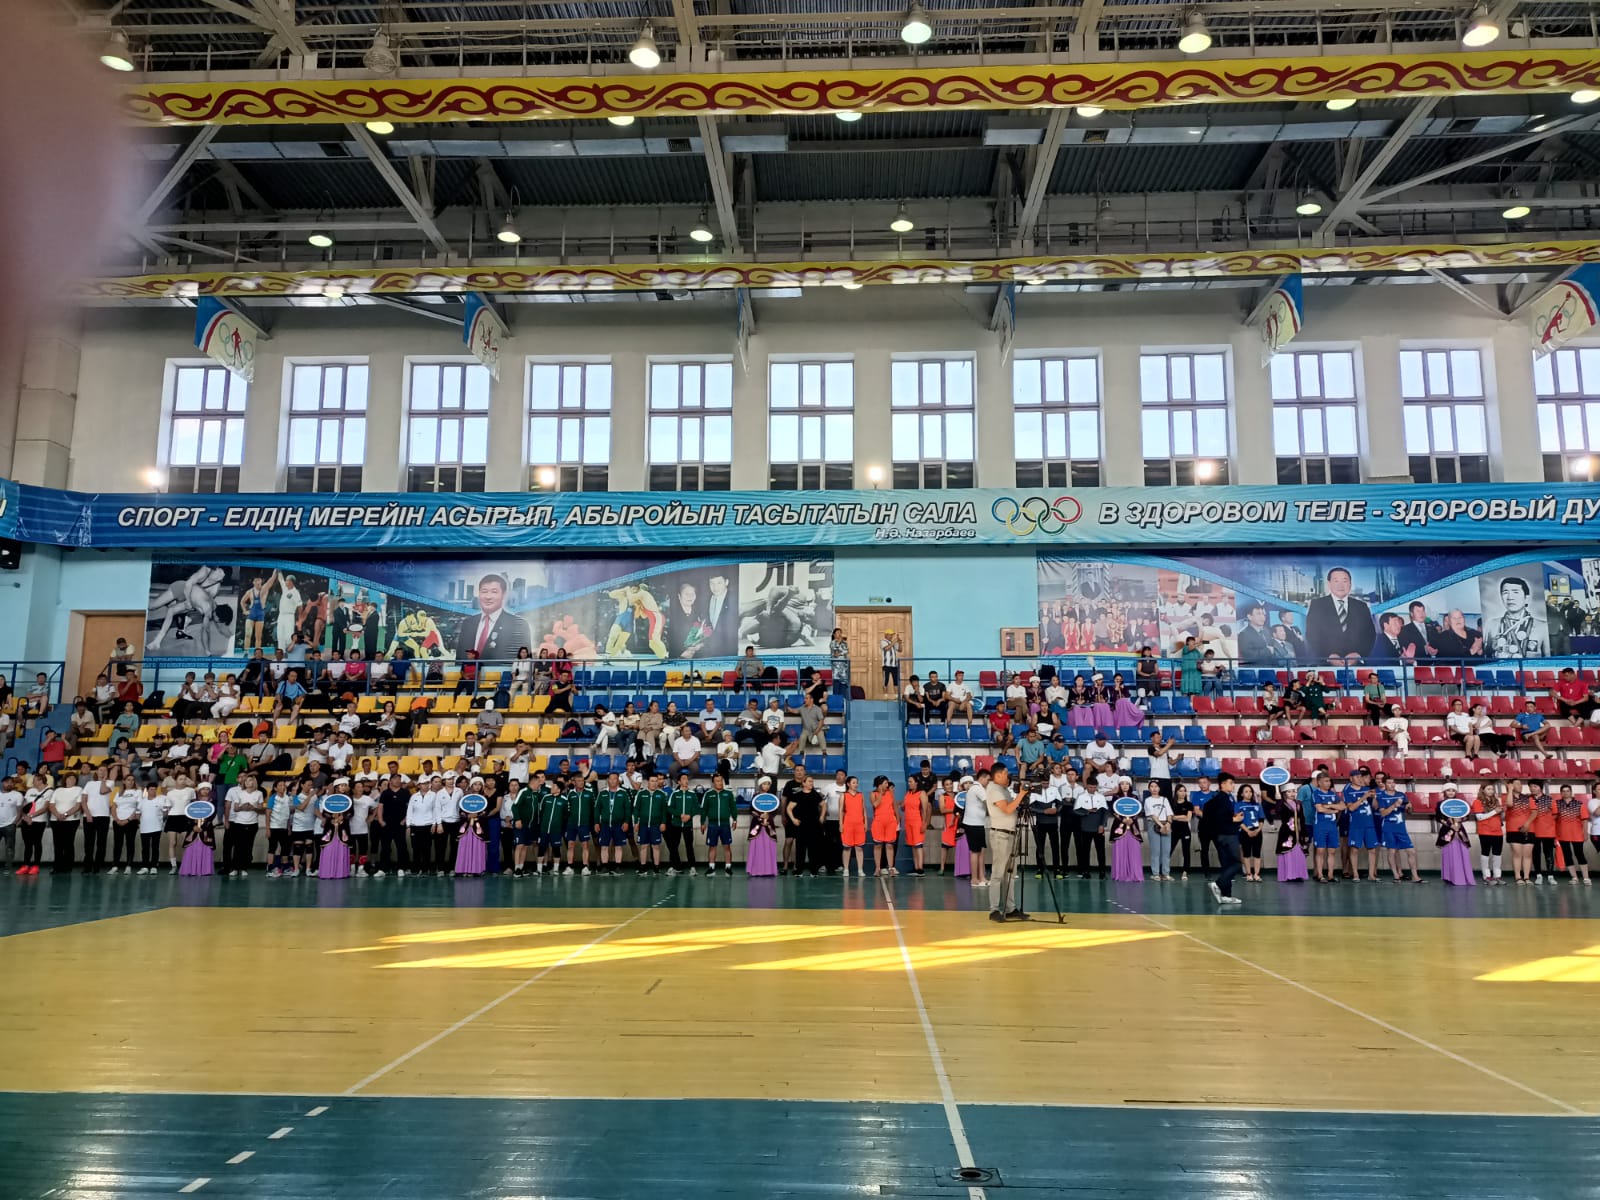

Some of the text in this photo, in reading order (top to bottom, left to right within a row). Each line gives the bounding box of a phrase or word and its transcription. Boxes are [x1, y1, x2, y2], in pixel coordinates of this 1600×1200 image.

[118, 506, 206, 528] СПОРТ
[223, 506, 304, 532] ЕЛДІҢ
[308, 502, 425, 527] МЕРЕЙІН
[428, 506, 557, 529] АСЫРЫП,
[565, 500, 725, 527] АБЫРОЙЫН
[733, 502, 897, 526] ТАСЫТАТЫН
[903, 502, 977, 524] САЛА
[1098, 503, 1118, 523] В
[1124, 501, 1287, 527] ЗДОРОВОМ
[1295, 500, 1367, 522] ТЕЛЕ
[1390, 494, 1556, 526] ЗДОРОВЫЙ
